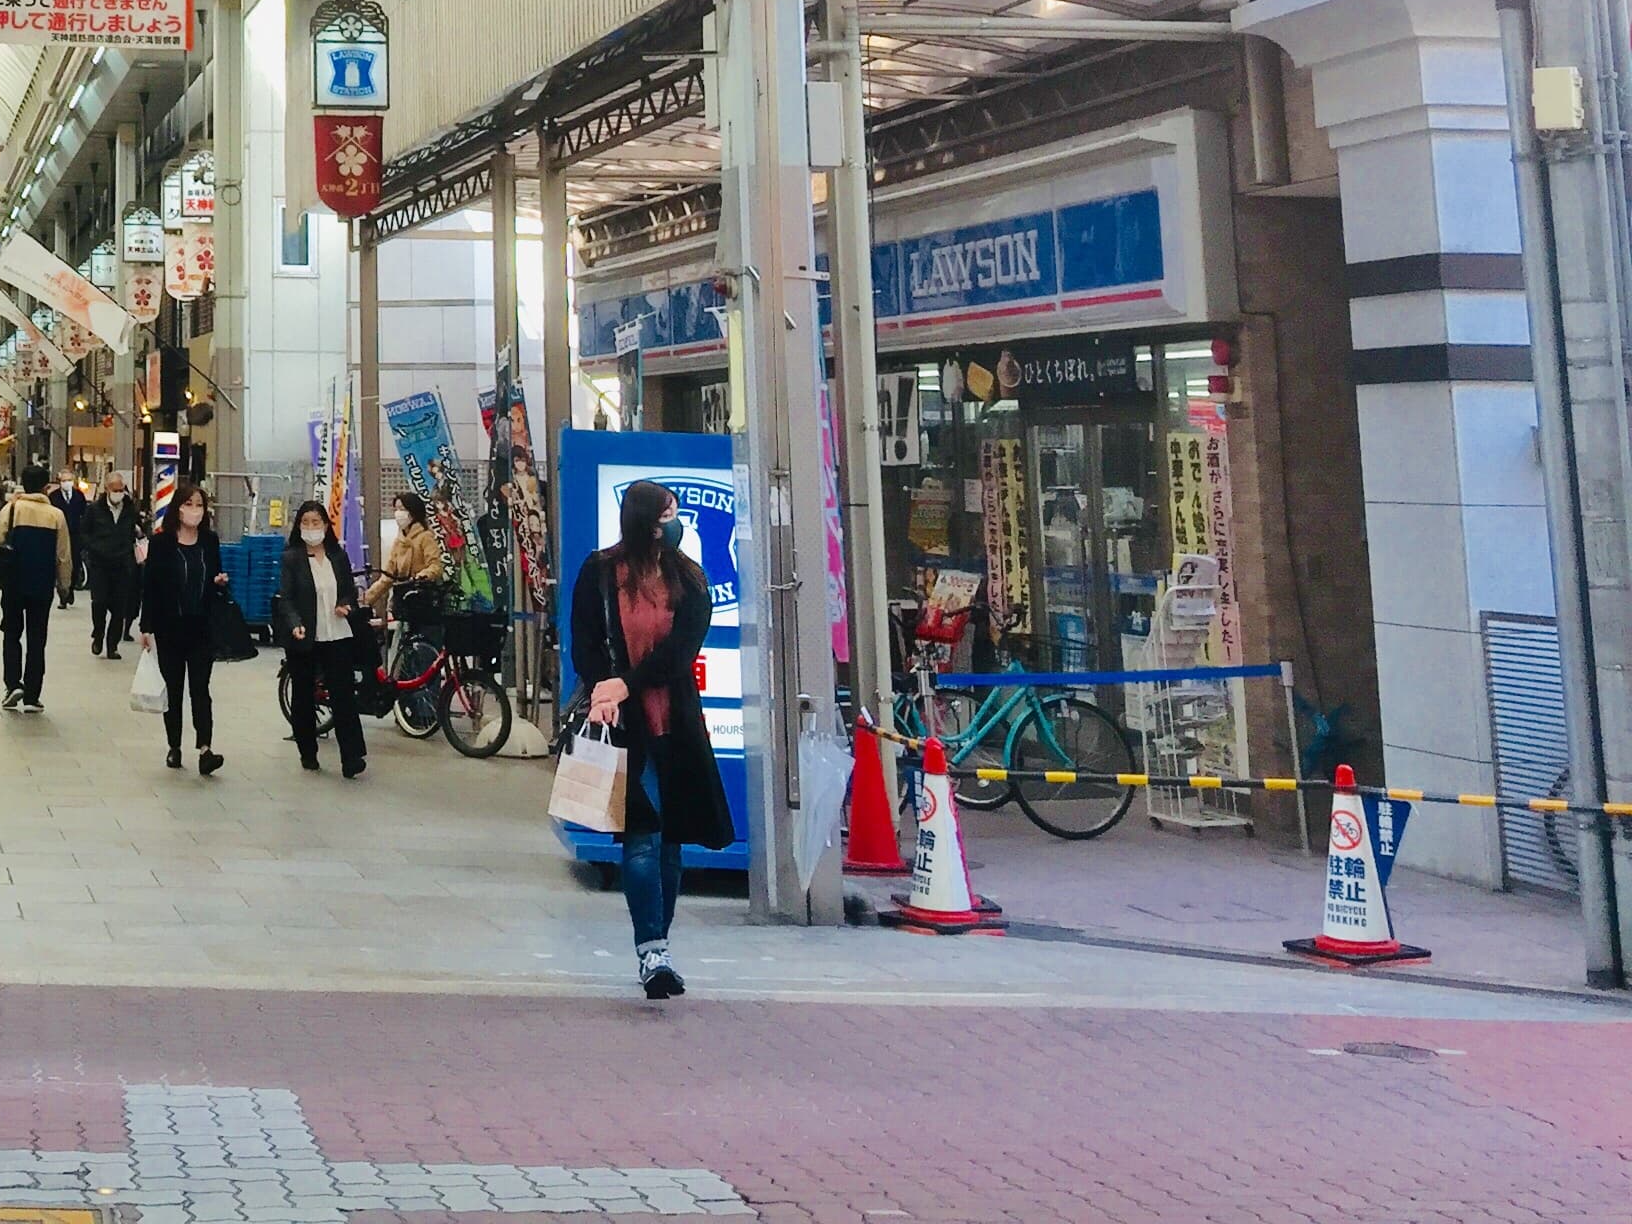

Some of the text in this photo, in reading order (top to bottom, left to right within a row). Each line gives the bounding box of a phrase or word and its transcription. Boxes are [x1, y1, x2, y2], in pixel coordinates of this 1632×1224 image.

[332, 85, 374, 96] STATION
[910, 229, 1040, 298] LAWSON
[1378, 801, 1394, 856] 駐輪禁止
[1328, 855, 1365, 880] 駐輪
[1328, 879, 1366, 903] 禁止
[1336, 904, 1366, 916] BICYCLE
